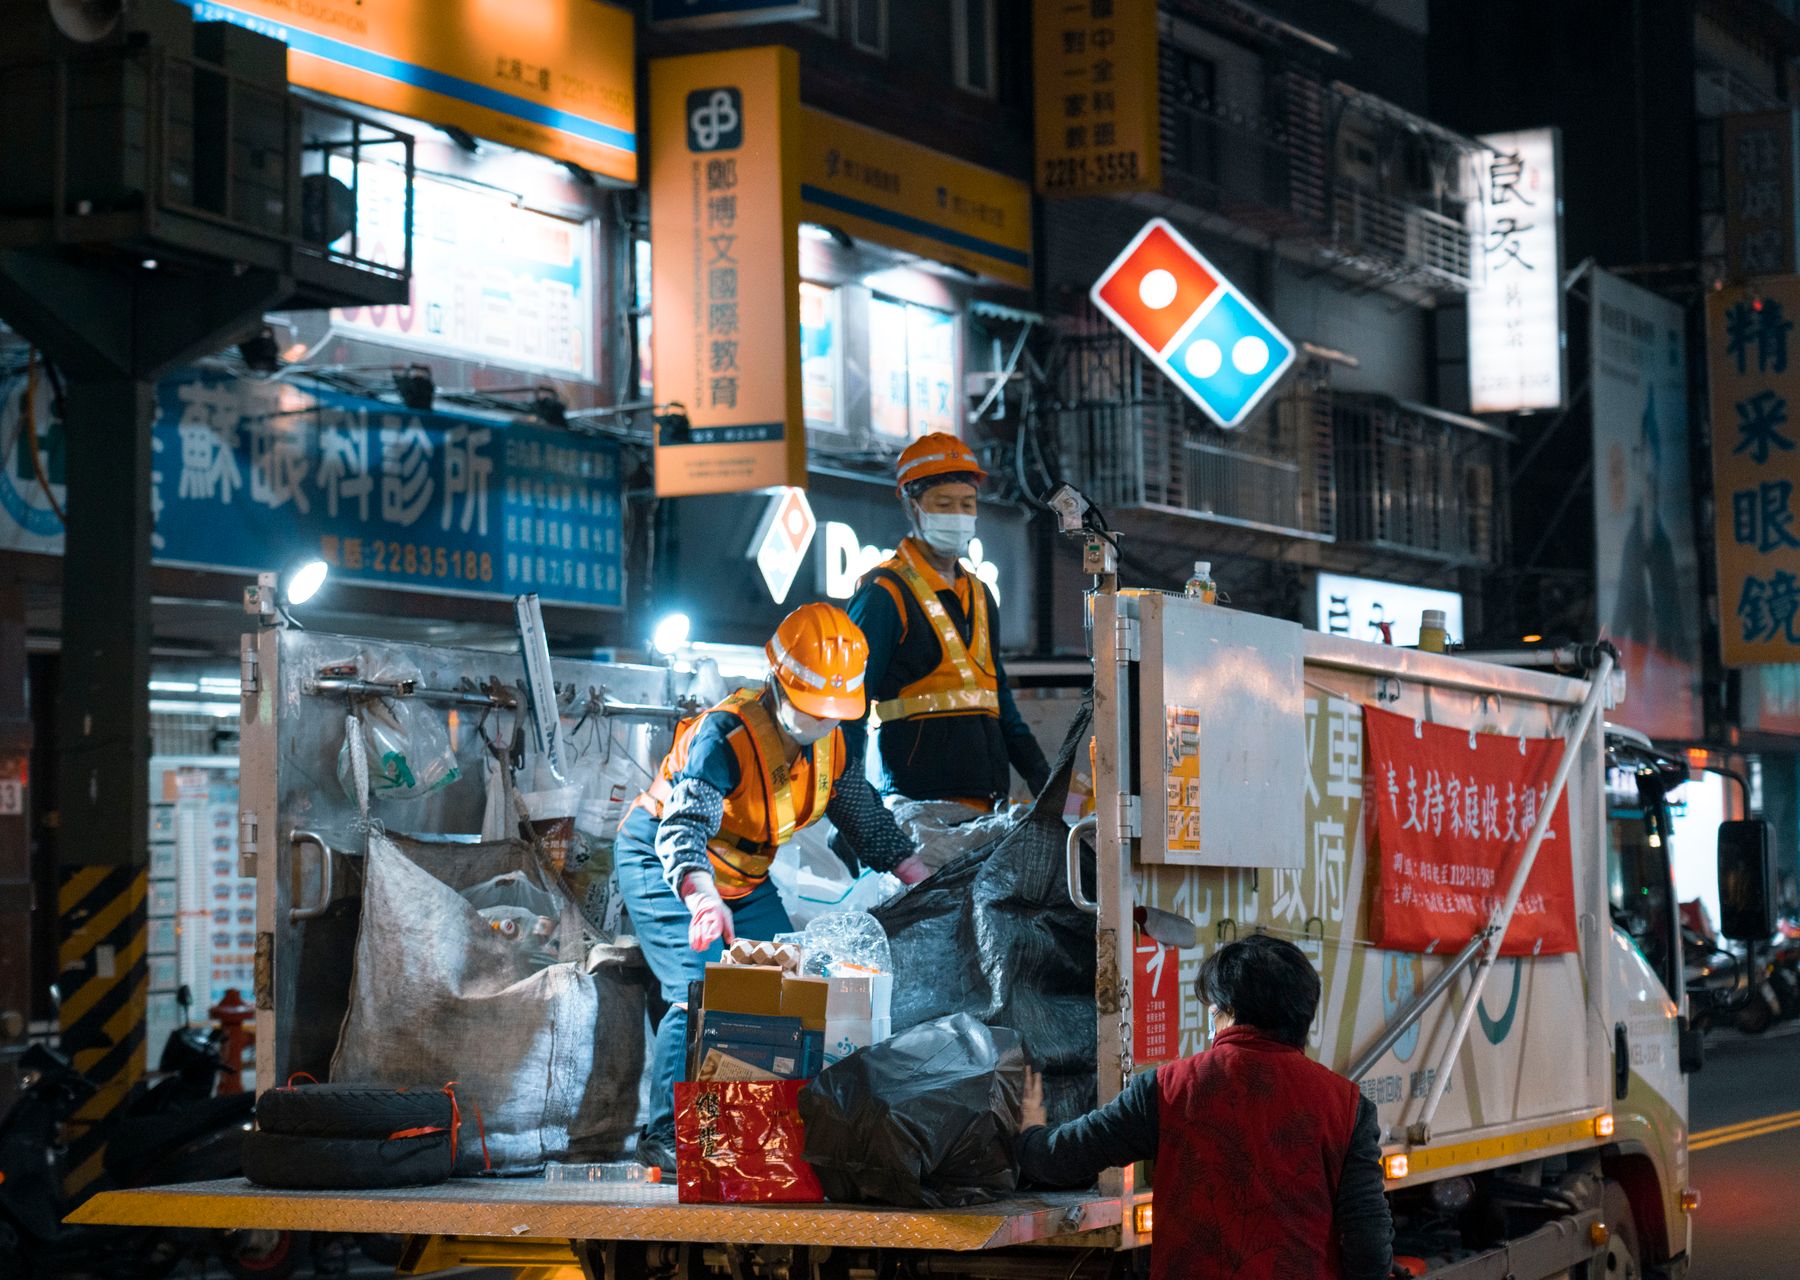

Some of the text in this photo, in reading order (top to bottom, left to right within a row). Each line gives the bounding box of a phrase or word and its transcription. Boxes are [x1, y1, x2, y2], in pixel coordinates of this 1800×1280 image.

[706, 158, 740, 409] 鄭博文國際教育
[178, 381, 493, 537] 蘇眼科診所
[1725, 299, 1800, 645] 精采眼鏡
[0, 784, 16, 809] 3
